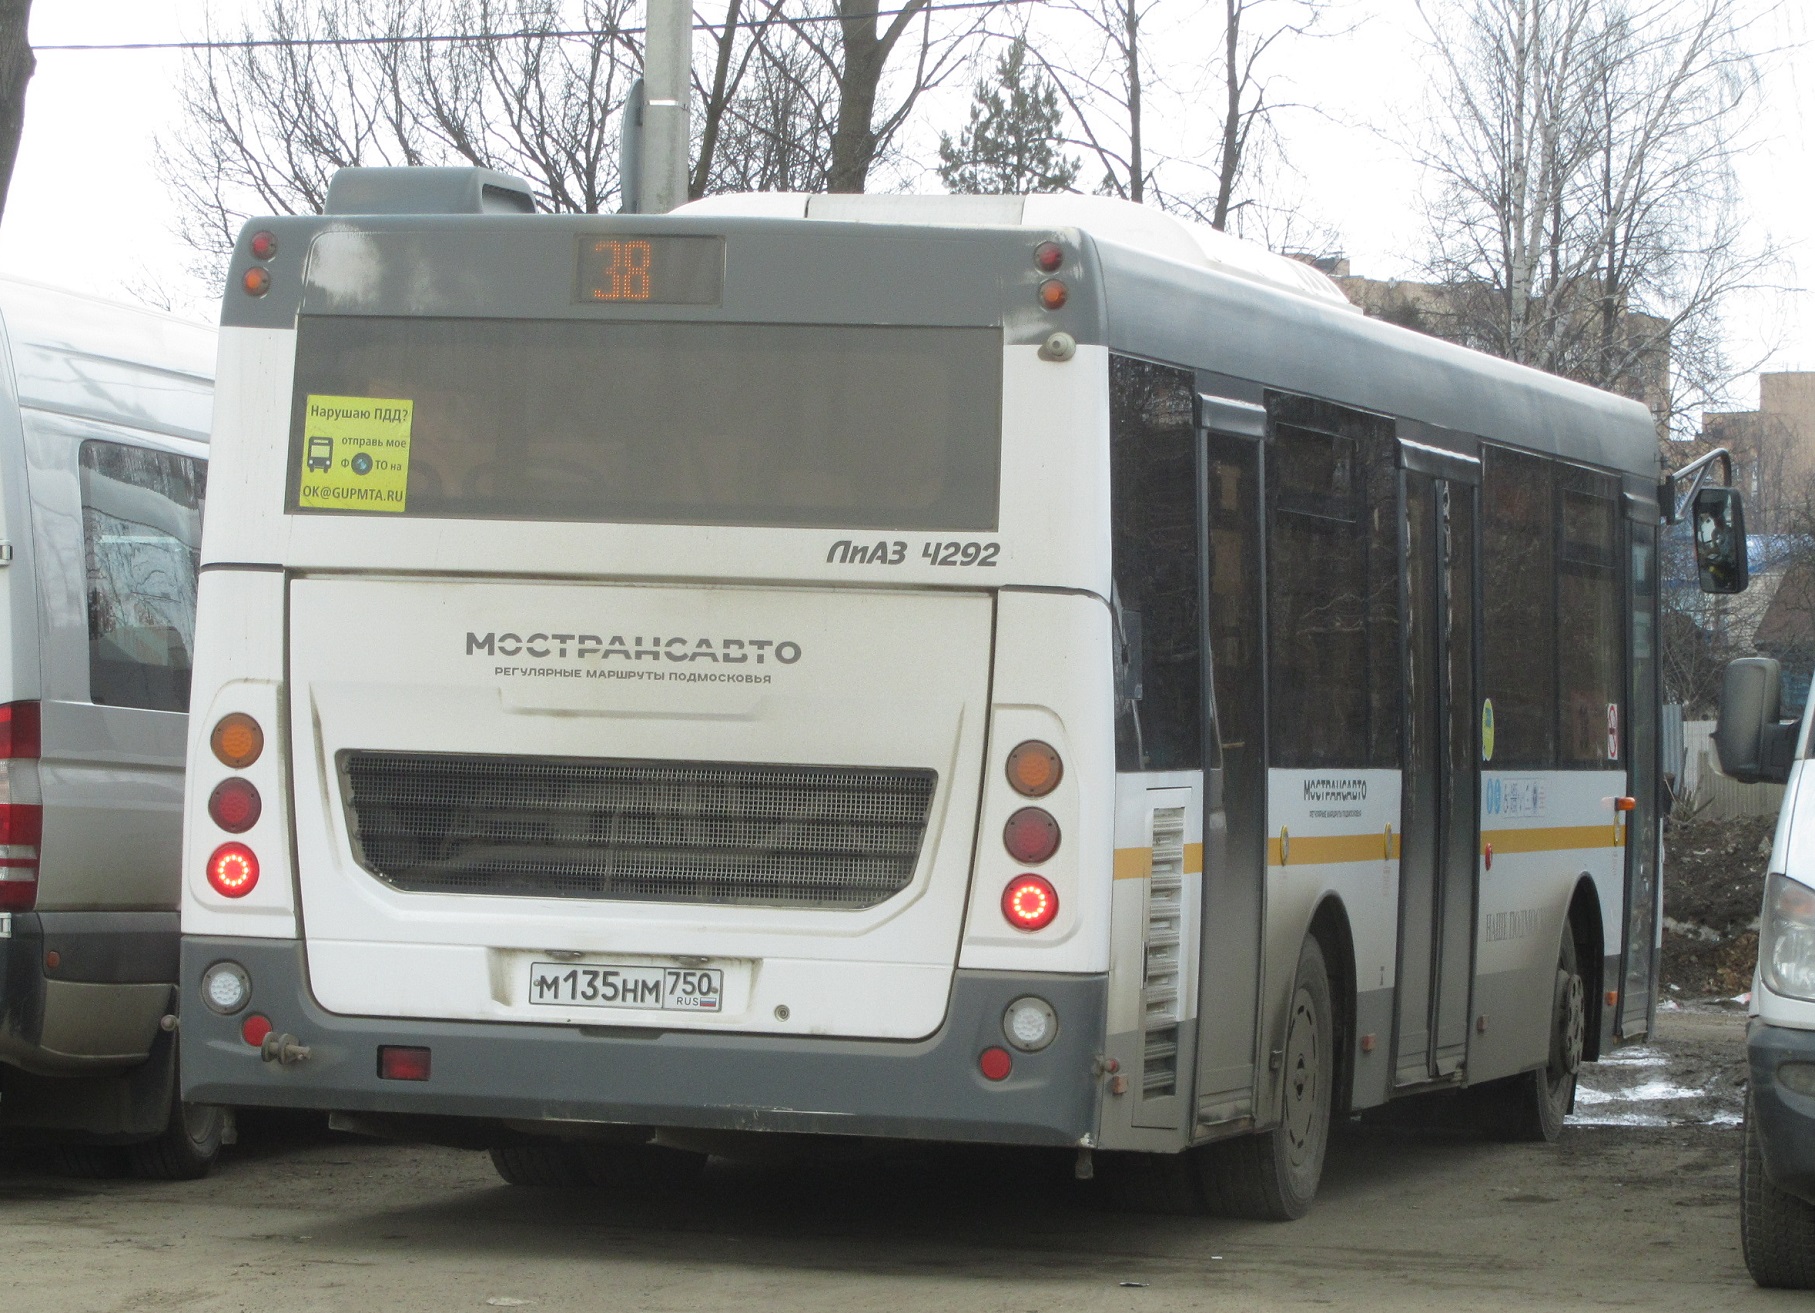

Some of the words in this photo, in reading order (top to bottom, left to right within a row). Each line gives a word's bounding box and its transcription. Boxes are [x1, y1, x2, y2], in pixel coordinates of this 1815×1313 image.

[594, 240, 650, 299] 38
[310, 405, 370, 421] Нарушаю
[374, 408, 408, 423] ПДД?
[341, 437, 383, 448] отправь
[386, 439, 406, 448] мое
[390, 462, 402, 471] на
[302, 485, 403, 502] OK@GUPMTA.RU
[921, 541, 1001, 567] 4292
[466, 632, 802, 664] МОСТРАНСАВТО
[495, 666, 582, 678] РЕГУЛЯРНЫЕ
[586, 669, 665, 681] МАРШРУТЫ
[668, 672, 772, 683] ПОДМОСКОВЬЯ
[667, 971, 713, 997] 750
[676, 997, 699, 1006] RUS
